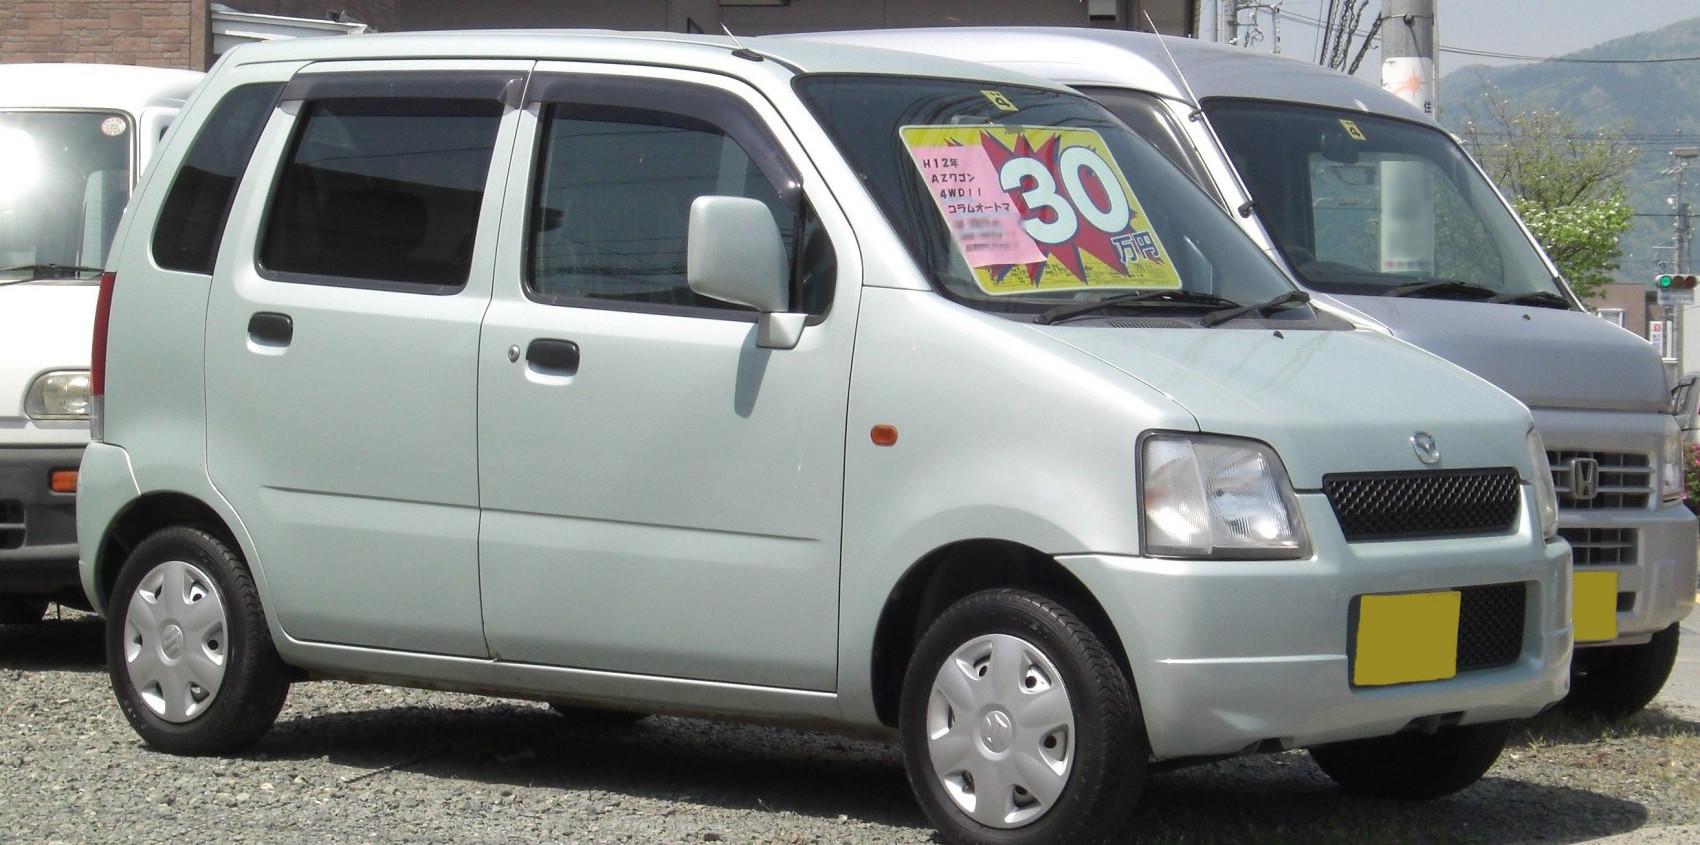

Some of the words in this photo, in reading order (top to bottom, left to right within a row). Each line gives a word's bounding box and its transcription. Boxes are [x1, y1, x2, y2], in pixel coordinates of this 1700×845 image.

[922, 158, 960, 169] H12年
[931, 172, 976, 184] AZワゴン
[948, 201, 1011, 215] コラムオートマ
[1000, 146, 1130, 243] 30
[1111, 230, 1160, 265] 万円
